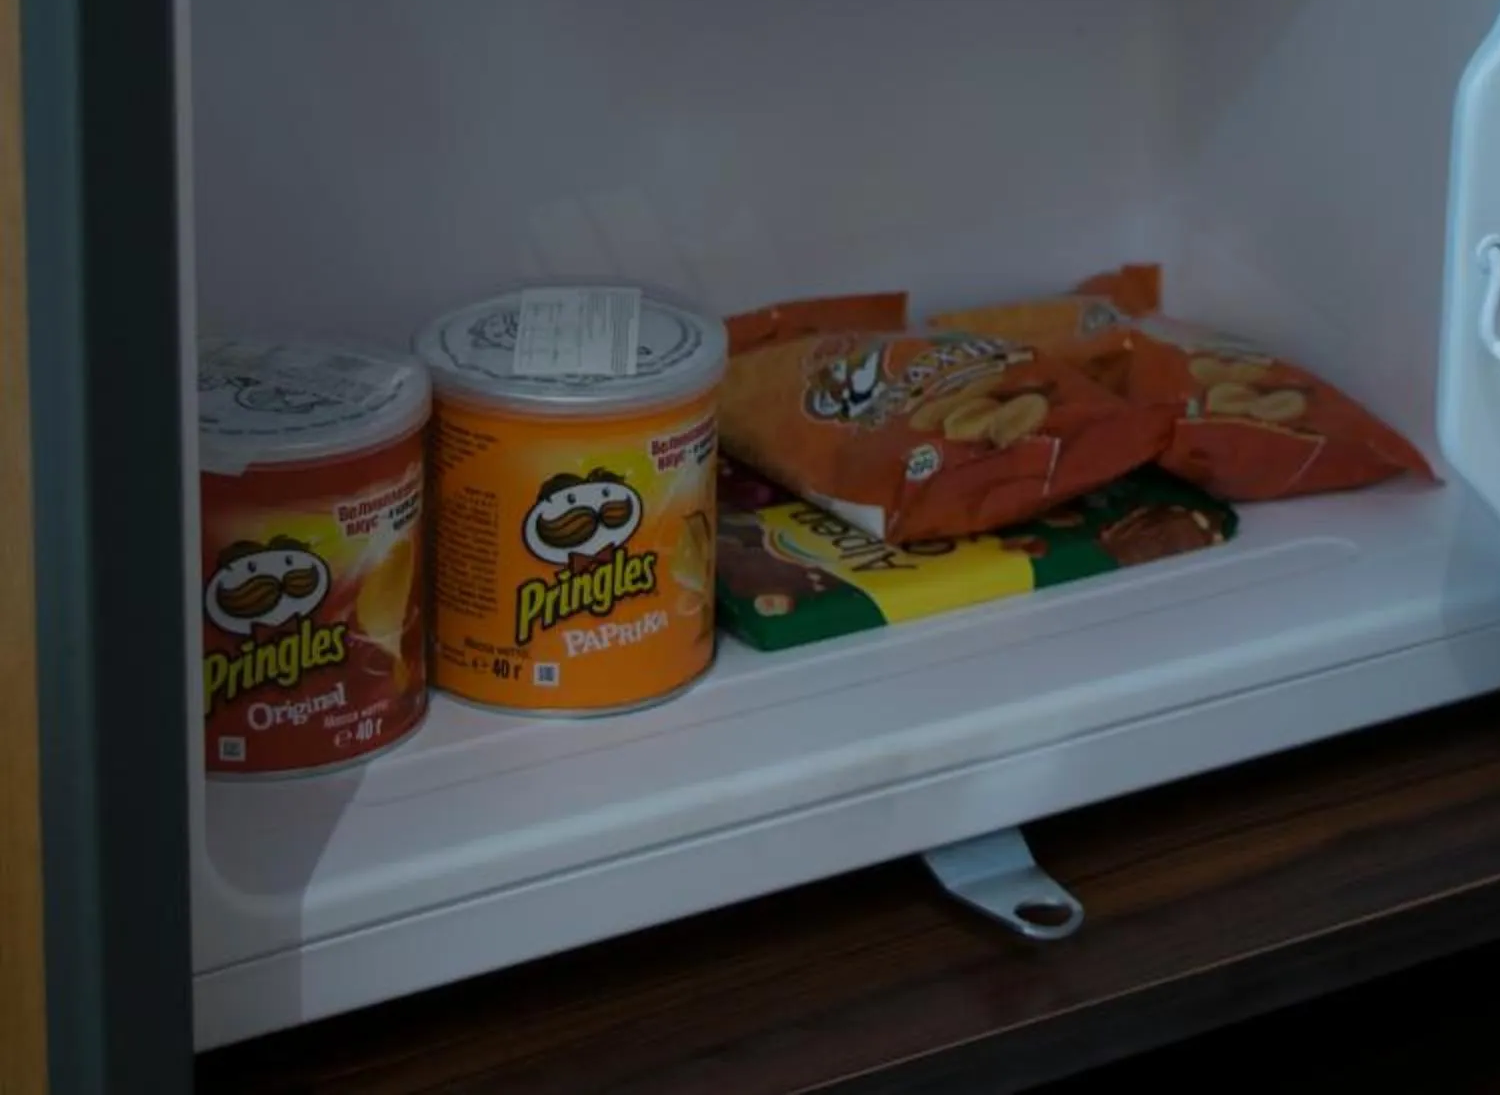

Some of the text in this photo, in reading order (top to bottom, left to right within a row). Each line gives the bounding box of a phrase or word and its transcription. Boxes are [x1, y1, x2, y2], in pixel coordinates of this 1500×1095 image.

[518, 547, 658, 646] Pringles
[202, 616, 348, 717] Pringles
[246, 681, 348, 732] Original
